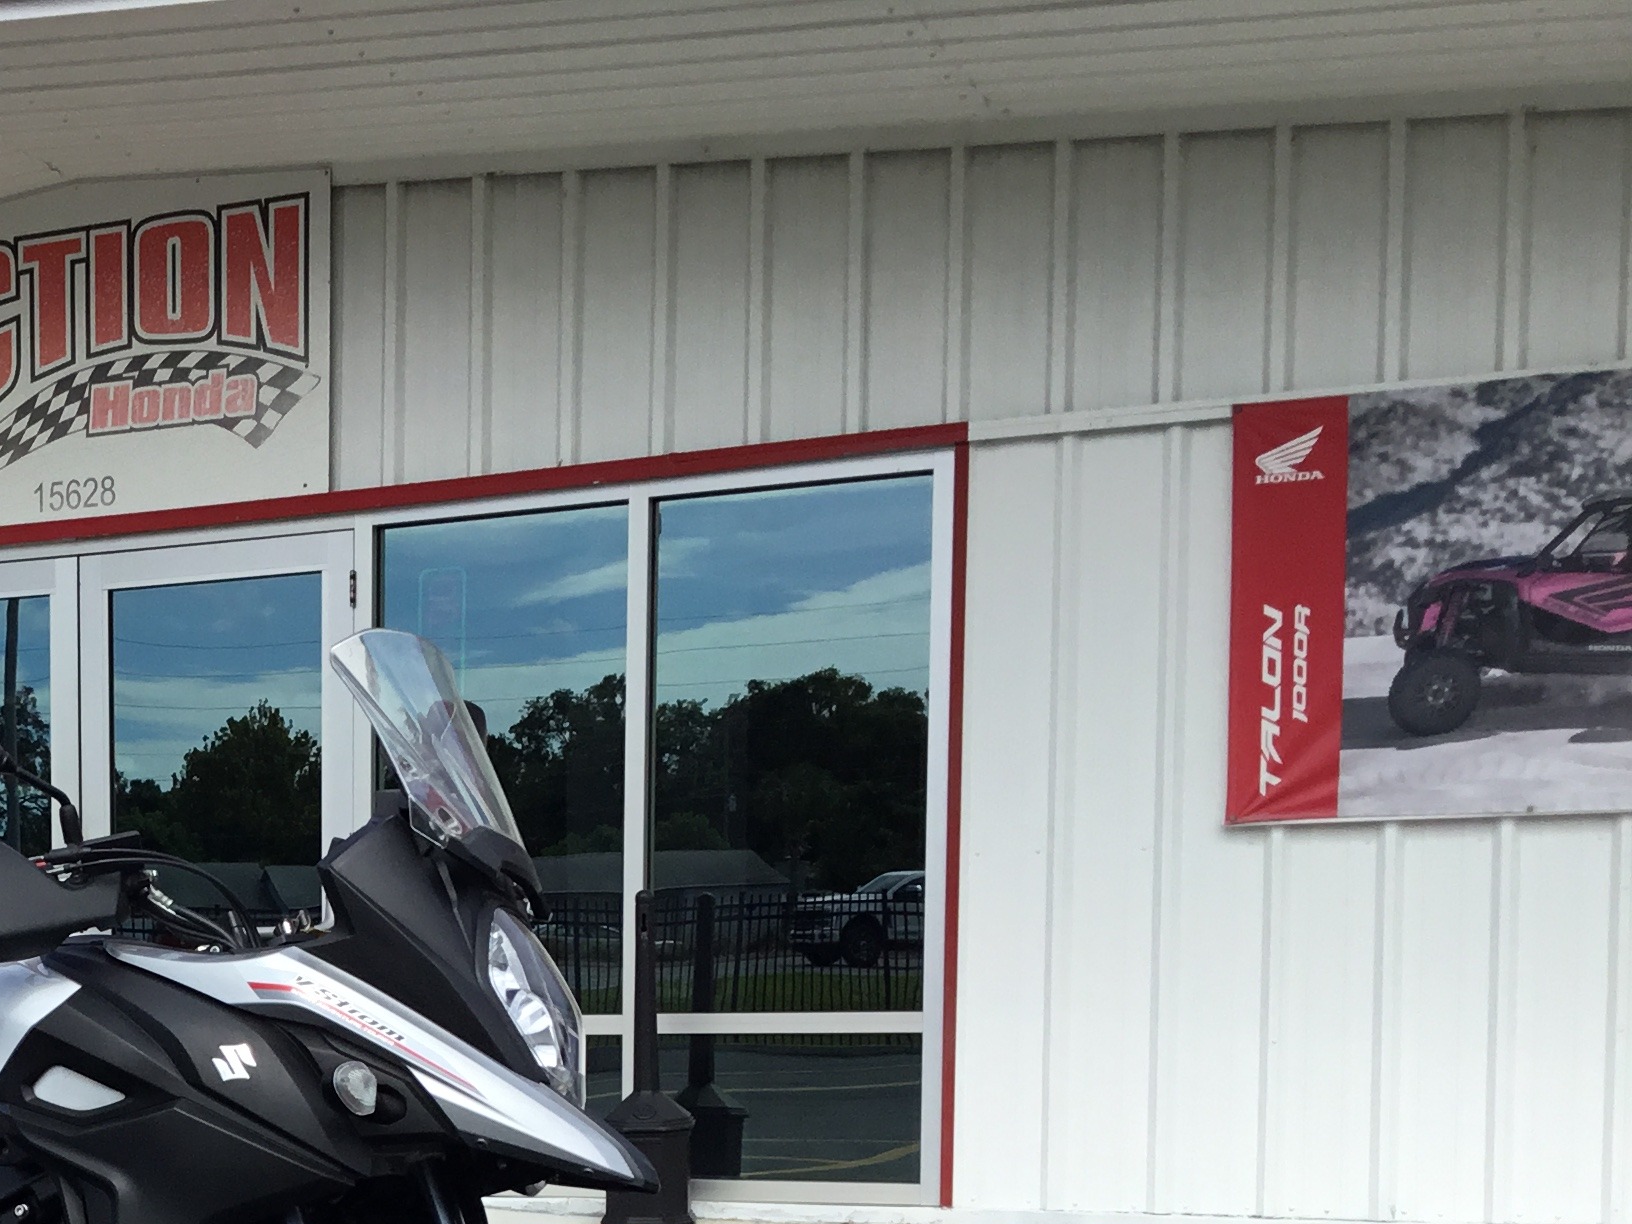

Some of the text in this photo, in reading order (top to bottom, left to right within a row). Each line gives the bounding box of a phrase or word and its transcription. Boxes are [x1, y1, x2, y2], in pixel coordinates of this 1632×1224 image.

[87, 367, 260, 437] Honda
[33, 475, 117, 513] 15628
[1255, 470, 1325, 484] HONDA
[1292, 604, 1311, 723] 1000R
[1259, 604, 1283, 797] TALON
